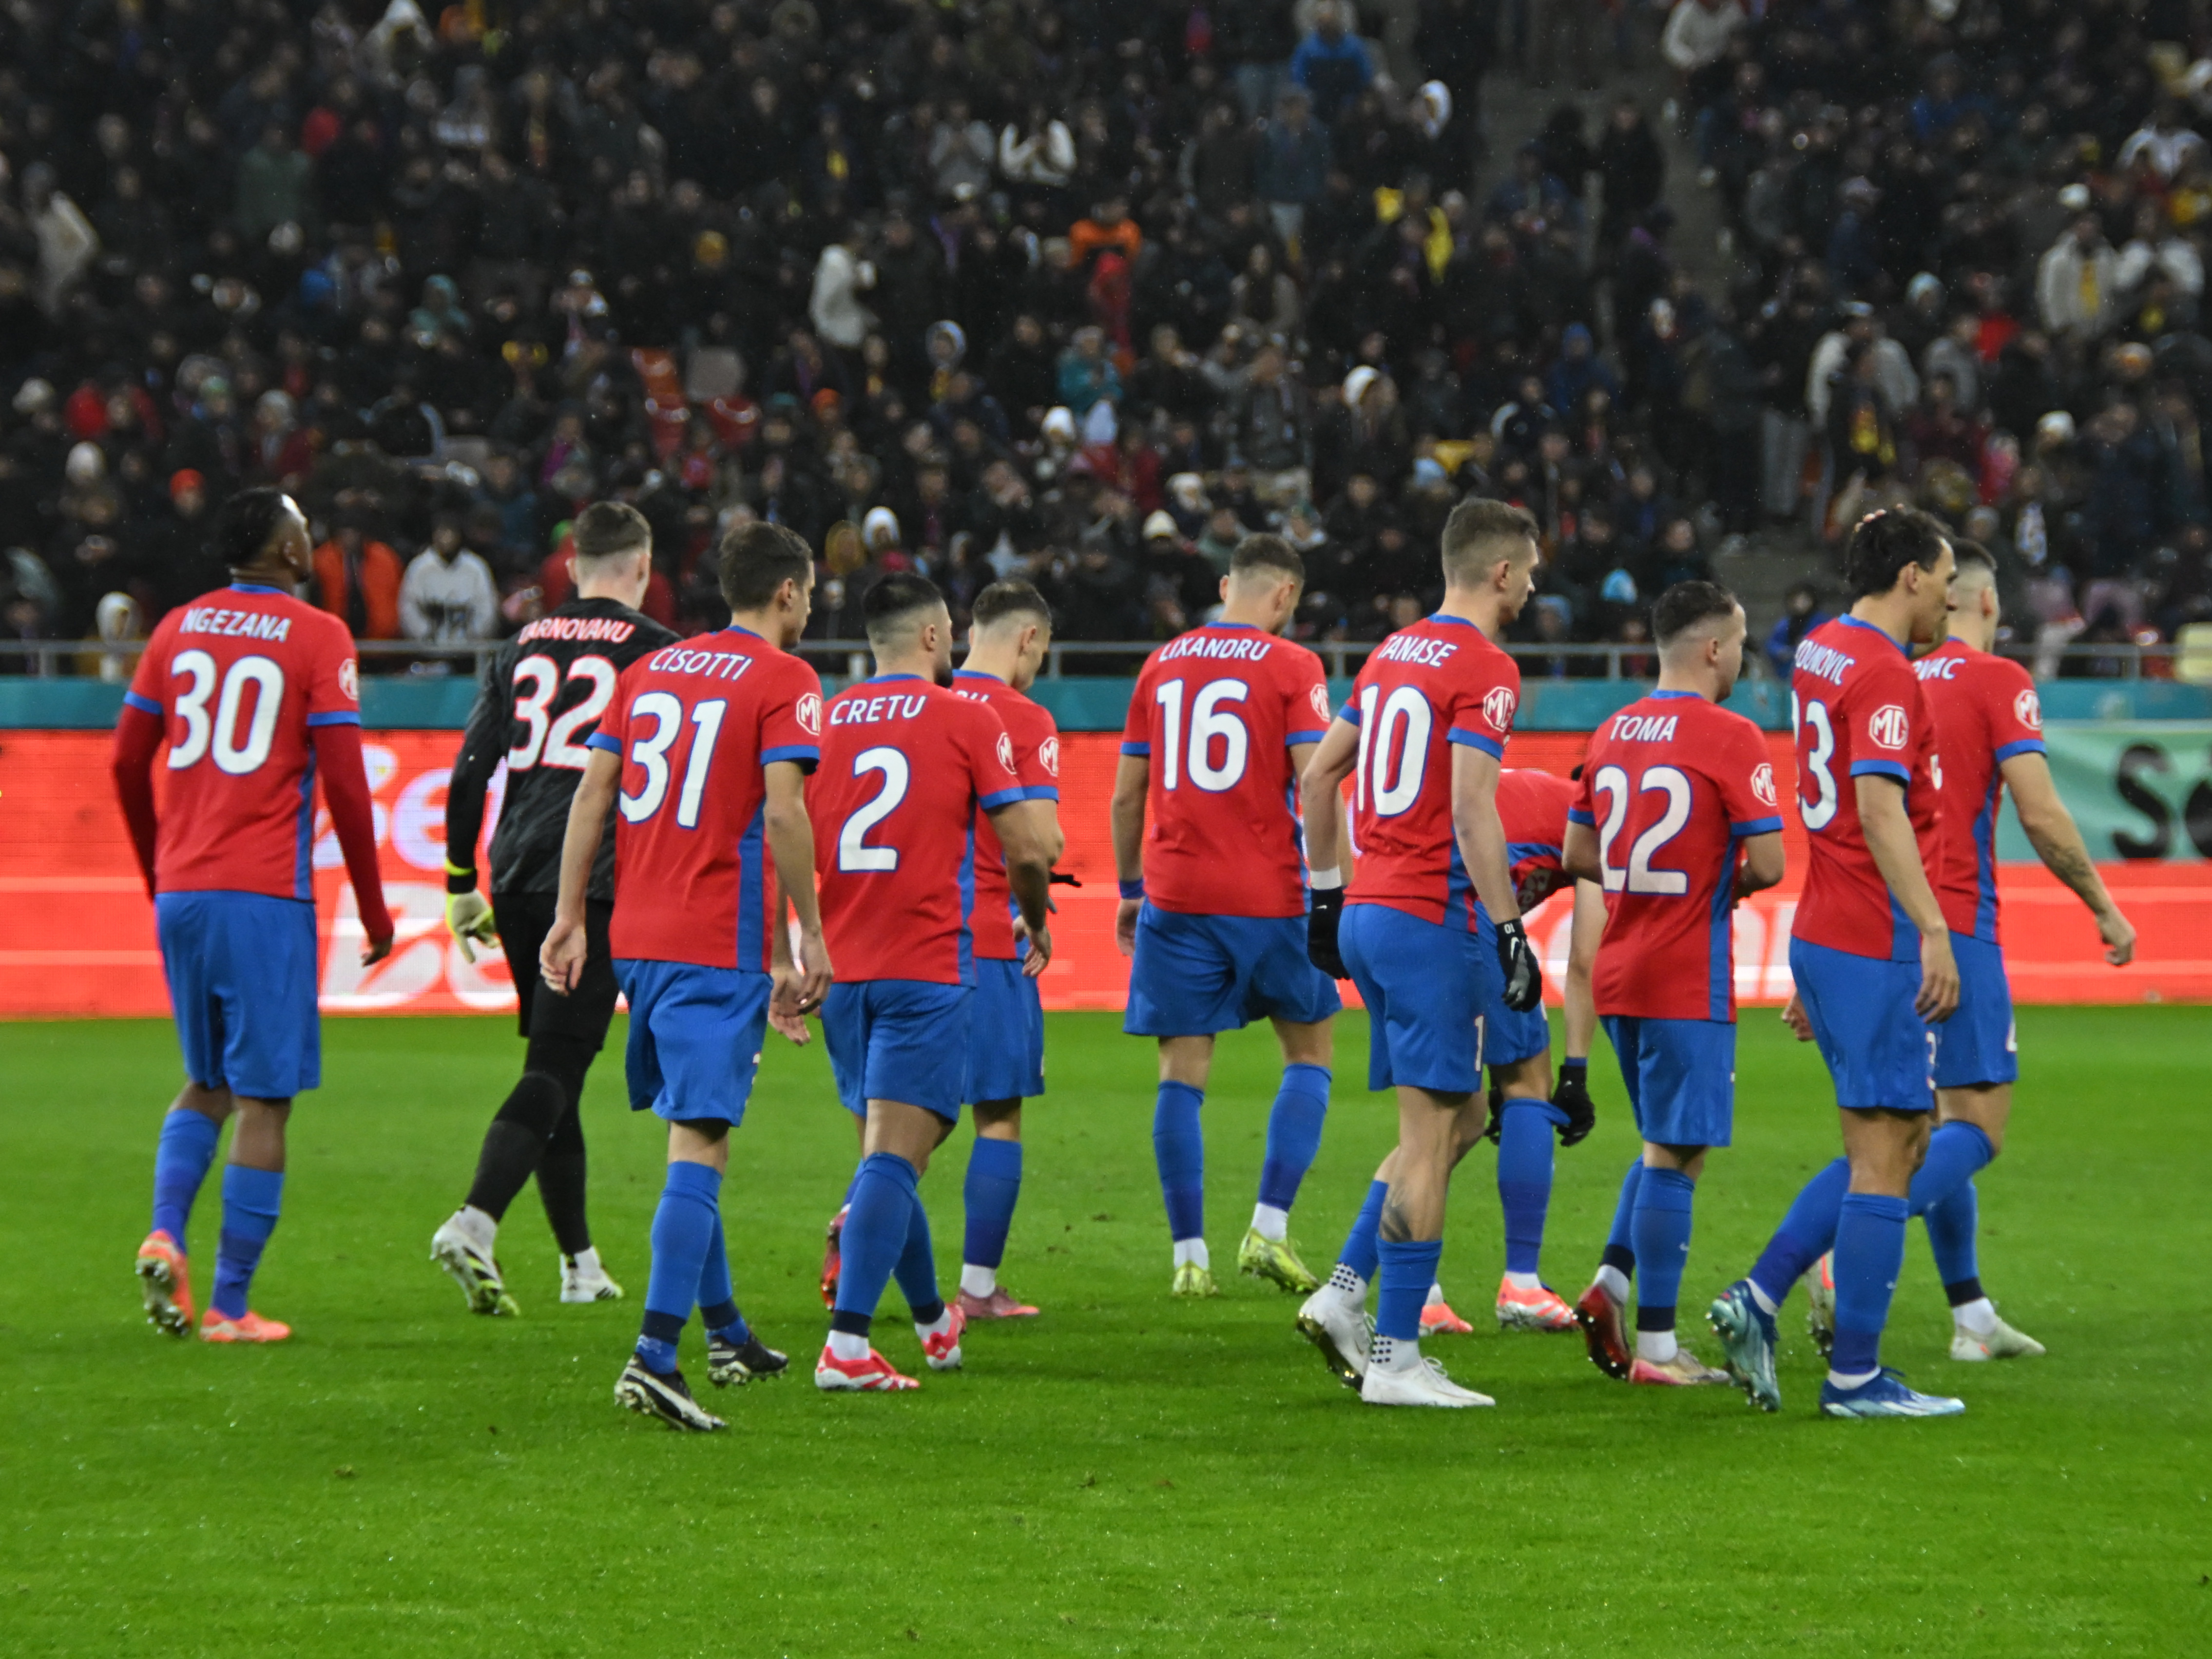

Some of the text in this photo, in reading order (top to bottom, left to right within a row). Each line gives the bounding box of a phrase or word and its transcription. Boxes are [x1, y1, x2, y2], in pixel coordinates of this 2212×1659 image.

[178, 606, 292, 643] NGEZANA
[1157, 636, 1272, 662] LIXANDRU
[1376, 635, 1459, 668] TANASE
[648, 646, 753, 682] CISOTTI
[166, 649, 285, 775] 30
[506, 654, 617, 772] 32
[829, 694, 927, 726] CRETU
[1155, 678, 1249, 793] 16
[1609, 714, 1679, 743] TOMA
[1873, 708, 1908, 745] MG
[619, 691, 728, 829] 31
[1353, 684, 1432, 817] 10
[838, 745, 910, 872] 2
[1595, 764, 1692, 895] 22
